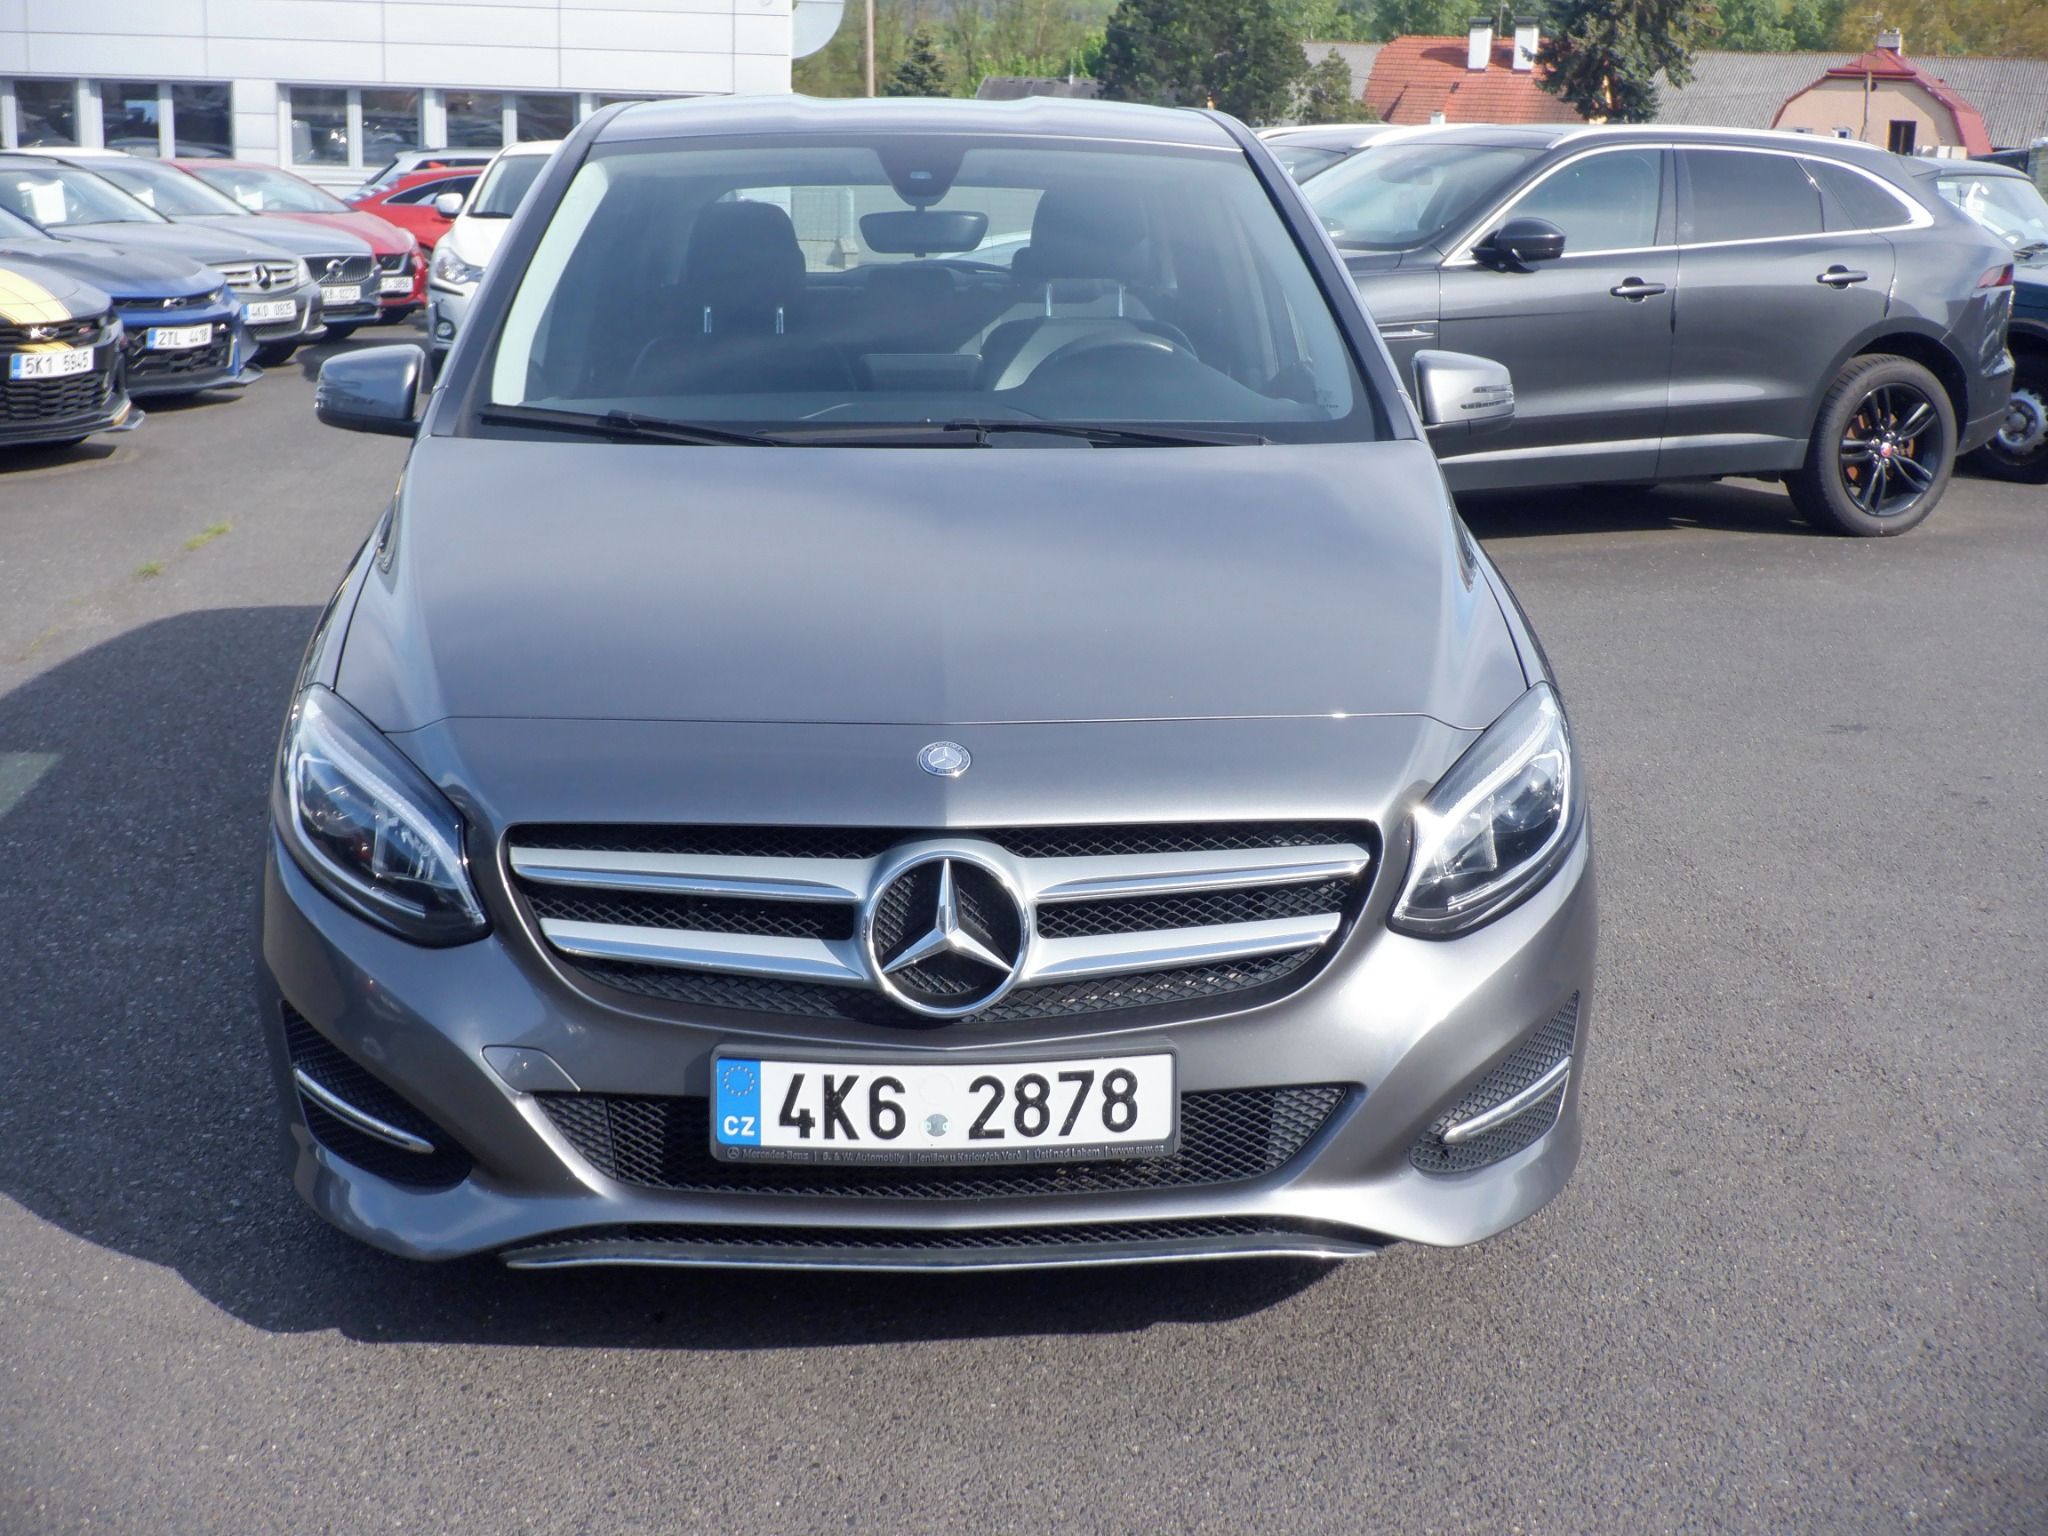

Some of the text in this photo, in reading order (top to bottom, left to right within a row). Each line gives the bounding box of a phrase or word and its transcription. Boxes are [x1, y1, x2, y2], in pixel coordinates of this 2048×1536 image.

[158, 331, 181, 346] 2TL
[26, 356, 52, 375] 5K1
[778, 1068, 1139, 1140] 4K6 2878
[724, 1115, 755, 1137] CZ
[742, 1149, 809, 1160] Mercedes-Benz
[855, 1151, 904, 1163] Automobily
